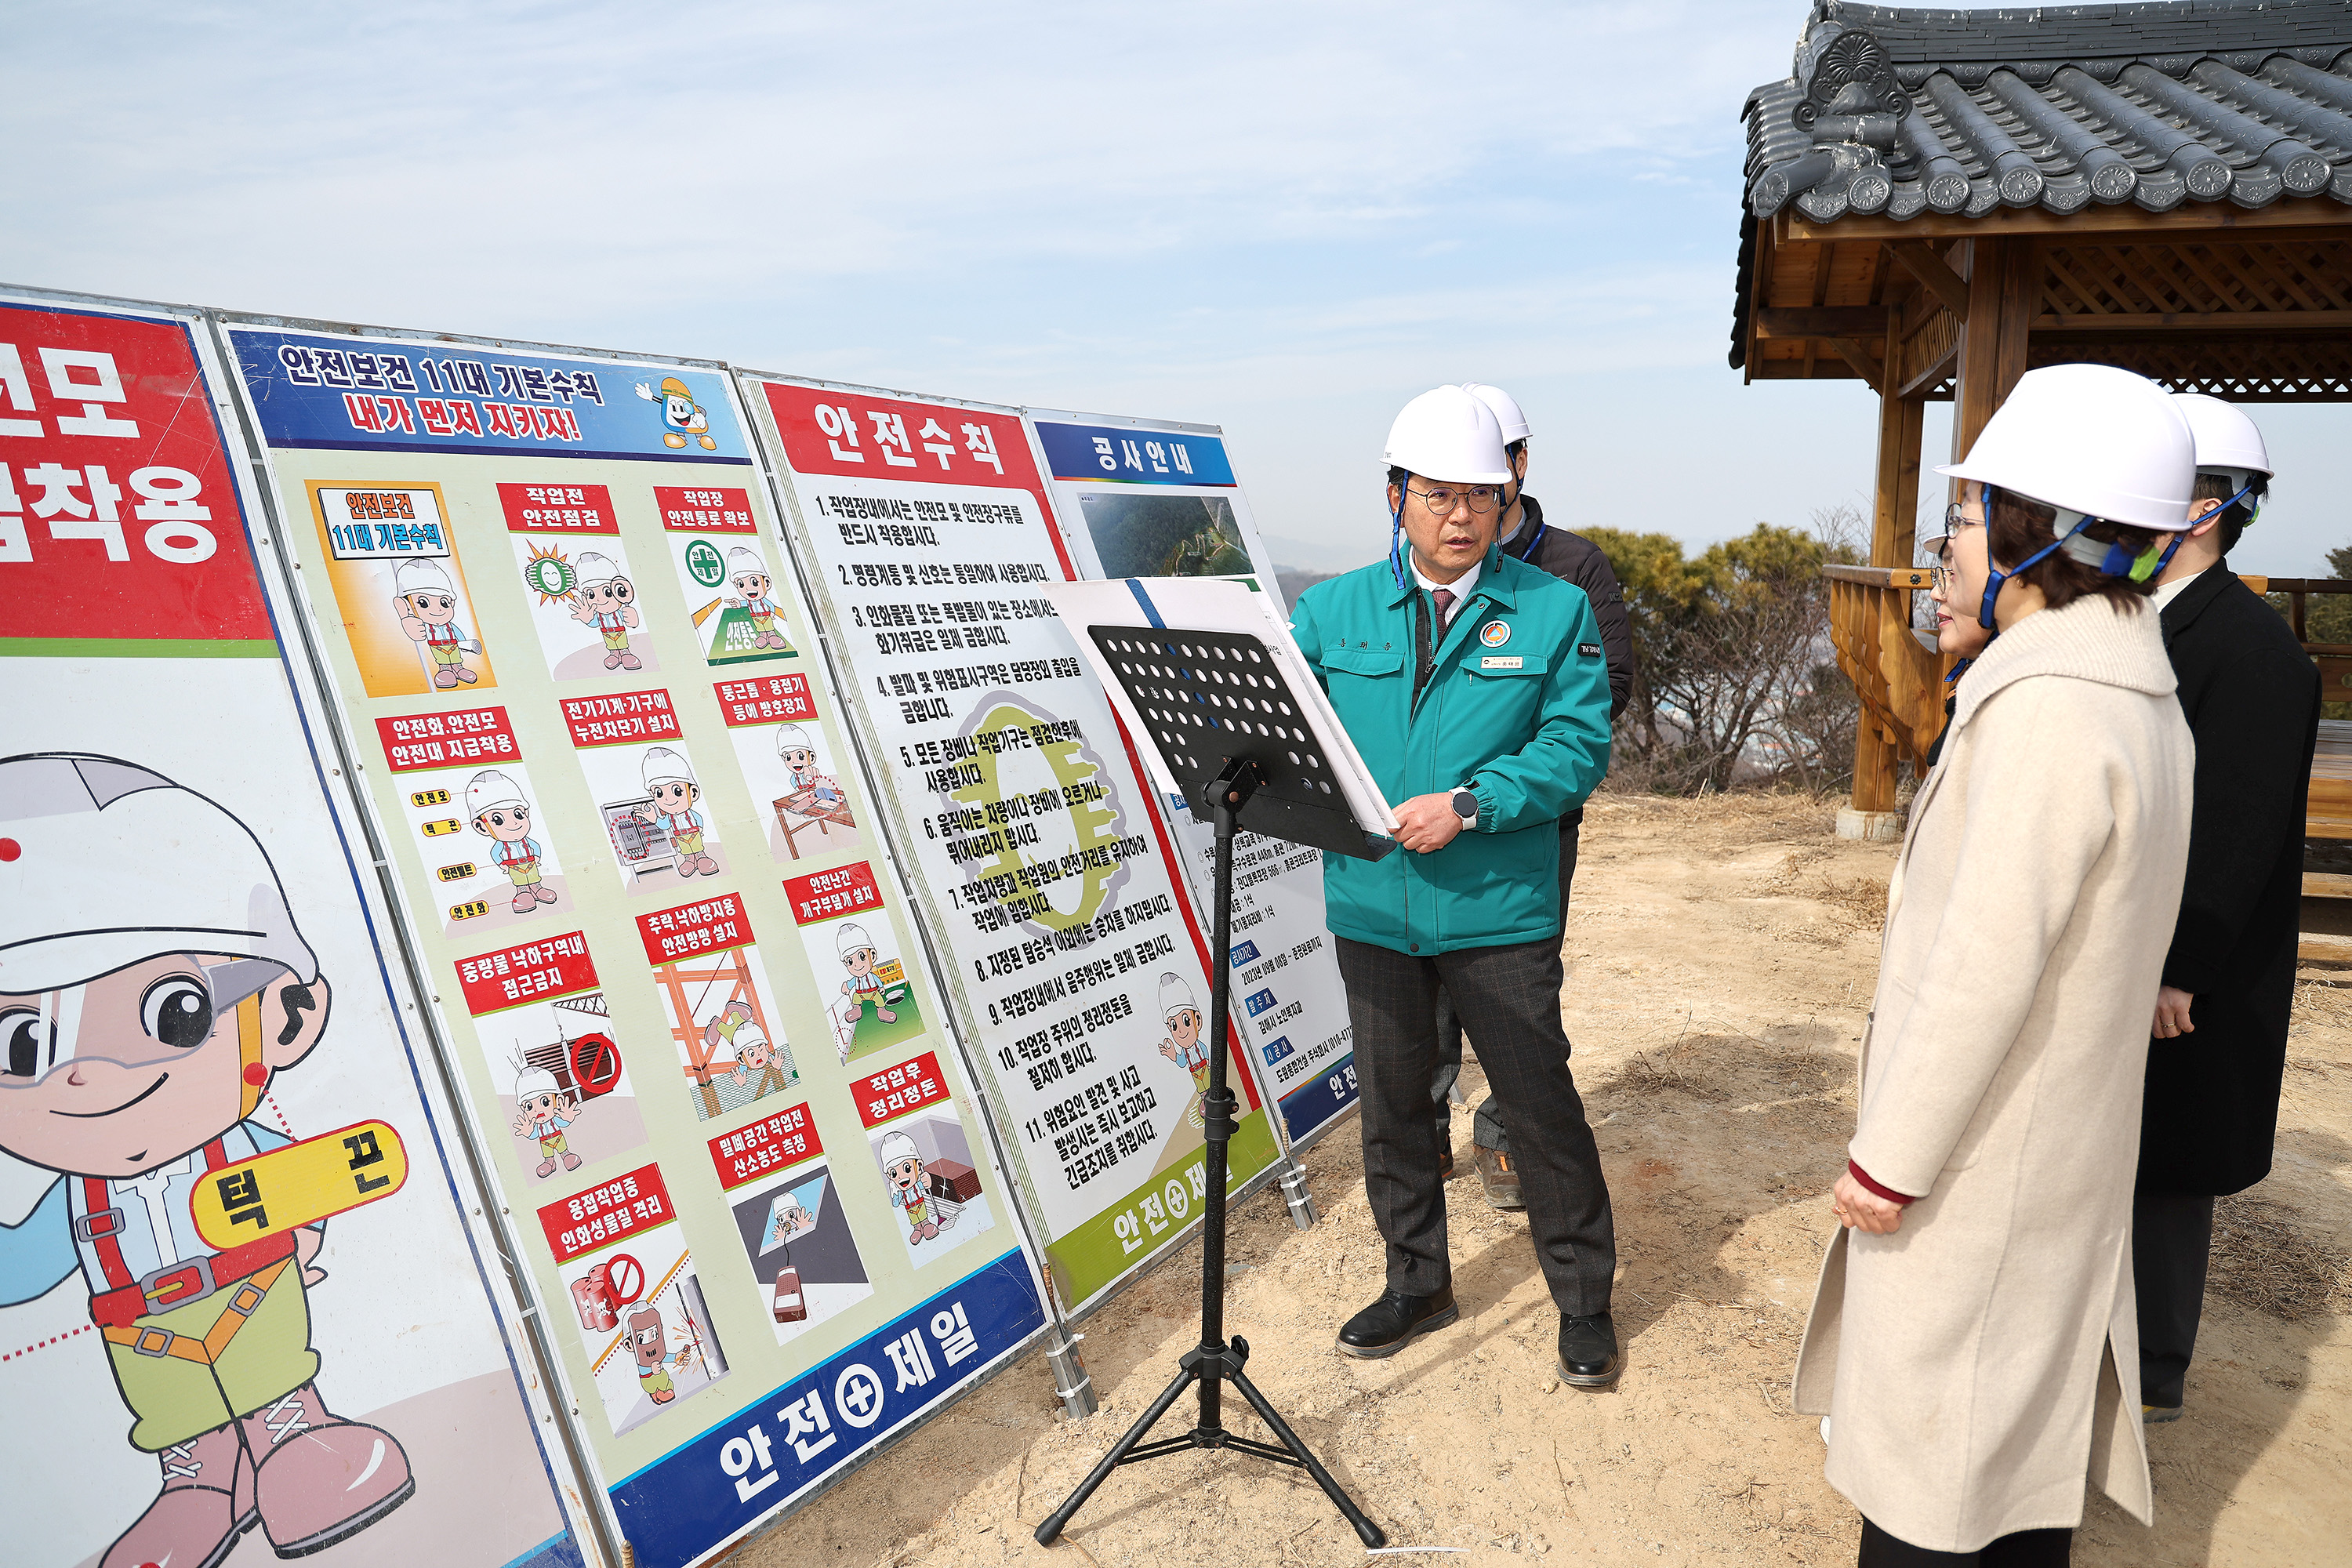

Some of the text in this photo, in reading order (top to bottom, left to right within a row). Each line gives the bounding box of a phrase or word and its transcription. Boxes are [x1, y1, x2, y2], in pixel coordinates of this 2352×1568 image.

[279, 345, 604, 405] 안전보건 11대 기본수칙
[343, 393, 583, 441] 내가 먼저 지키자!
[814, 403, 1004, 475] 안전수칙
[1092, 436, 1193, 474] 공사안내
[346, 492, 415, 519] 안전보건
[525, 487, 586, 506] 작업전
[684, 490, 724, 508] 작업장
[815, 495, 1024, 524] 1. 작업장내에서는 안전모 및 안전장구류를
[522, 508, 601, 528] 안전점검
[667, 509, 750, 527] 안전통로 확보
[838, 522, 940, 546] 반드시 착용합시다.
[332, 524, 443, 550] 11대 기본수칙
[837, 564, 853, 585] 2.
[903, 564, 918, 586] 및
[918, 564, 954, 585] 신호는
[954, 563, 999, 584] 통일하여
[1000, 563, 1051, 583] 사용합시다.
[851, 606, 867, 627] 3.
[866, 604, 916, 628] 인화물질
[916, 602, 942, 624] 또는
[942, 601, 988, 624] 폭발물이
[988, 601, 1011, 620] 있는
[875, 625, 1011, 655] 화기취급은 일체 금합시다.
[720, 677, 805, 702] 둥근톱 용접기
[877, 676, 890, 697] 4.
[890, 673, 917, 696] 발파
[917, 672, 933, 694] 및
[933, 663, 1011, 692] 위험표시구역은
[1051, 656, 1082, 678] 출입을
[567, 692, 669, 720] 전기기계·기구에
[732, 696, 807, 721] 등에 방호장치
[899, 698, 953, 724] 금합니다.
[393, 712, 497, 740] 안전화.안전모
[574, 713, 676, 742] 누전차단기 설치
[899, 719, 1083, 768] 5. 모든 장비나 작업기구는 점검한후에
[392, 734, 513, 767] 안전대 지급착용
[925, 763, 986, 793] 사용합시다.
[924, 780, 1103, 839] 6. 움직이는 차량이나 장비에 오르거나
[946, 822, 1041, 865] 뛰어내리지 맙시다.
[809, 870, 852, 894] 안전난간
[948, 834, 1149, 910] 7. 작업차량과 작업원의 안전거리를 유지하여
[648, 898, 736, 935] 추락,낙하방지용
[800, 885, 875, 919] 개구부덮개 설치
[972, 891, 1053, 935] 작업에 임합시다.
[1244, 893, 1255, 907] 1식
[1265, 905, 1276, 919] 1식
[662, 920, 738, 957] 안전방망 설치
[975, 893, 1173, 982] 8. 지정된 탑승석 이외에는 승차를 하지맙시다.
[1231, 945, 1252, 964] 공사기간
[462, 935, 585, 984] 중량물 낙하구역내
[1242, 936, 1323, 985] 2023년 09월 08일 준공완료까지
[502, 967, 563, 1000] 접근금지
[988, 933, 1176, 1026] 9. 작업장내에서 음주행위는 일체 금합시다.
[998, 993, 1133, 1071] 10. 작업장 주위의 정리정돈을
[1258, 1000, 1303, 1035] 김해시 노인복지과
[1027, 1041, 1097, 1091] 철저히 합시다.
[1308, 1040, 1330, 1062] 주식회사
[870, 1062, 921, 1091] 작업후
[1329, 1064, 1358, 1101] 안전
[869, 1078, 938, 1118] 정리정돈
[1025, 1065, 1142, 1143] 11. 위험요인 발견 및 사고
[768, 1109, 805, 1136] 작업전
[1054, 1087, 1157, 1162] 발생시는 즉시 보고하고
[734, 1134, 807, 1178] 산소농도 측정
[1064, 1118, 1158, 1191] 긴급조치를 취합시다.
[568, 1176, 639, 1221] 용접작업중
[561, 1195, 662, 1254] 인화성물질 격리
[1113, 1192, 1169, 1256] 안전
[720, 1301, 979, 1504] 안전 제일
